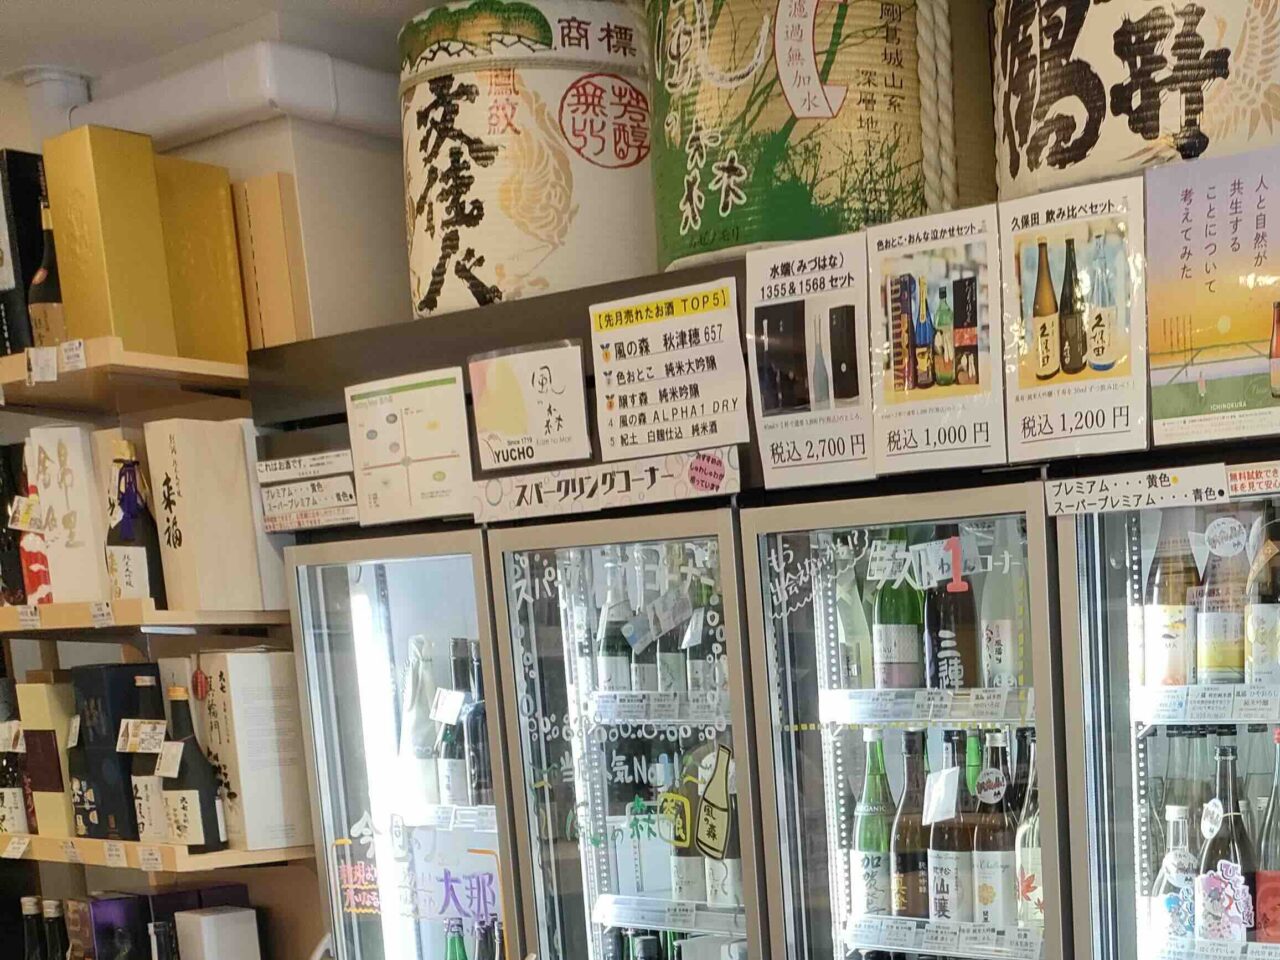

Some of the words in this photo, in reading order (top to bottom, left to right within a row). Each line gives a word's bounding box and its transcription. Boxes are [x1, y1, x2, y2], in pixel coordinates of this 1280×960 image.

[558, 18, 638, 57] 商標
[1010, 213, 1041, 232] 久保田
[1045, 201, 1116, 224] 飲み比べセット
[1229, 178, 1244, 253] 共生する
[1253, 174, 1270, 268] 人と自然が
[1179, 188, 1195, 280] 考えてみた
[1203, 185, 1218, 294] ことについて
[760, 276, 826, 301] 1355&1568
[828, 272, 855, 290] セット
[615, 338, 652, 361] 風の森
[704, 324, 723, 342] 657
[616, 367, 656, 386] 色おとこ
[664, 356, 718, 378] 純米大吟醸
[618, 392, 649, 409] 醸す森
[659, 383, 700, 404] 純米吟醸
[608, 419, 614, 428] 4
[619, 411, 647, 428] 風の森
[712, 398, 739, 415] DRY
[1020, 413, 1054, 439] 税込
[1059, 407, 1106, 433] 1,200
[1112, 404, 1130, 427] 円
[609, 436, 615, 446] 5
[692, 420, 719, 437] 純米酒
[886, 428, 920, 452] 税込
[924, 425, 967, 447] 1,000
[973, 421, 990, 443] 円
[494, 446, 535, 463] YUCHO
[771, 441, 801, 466] 税込
[806, 437, 846, 459] 2,700
[850, 434, 866, 455] 円
[515, 466, 674, 507] スパークリングコーナー
[162, 472, 183, 550] 来福
